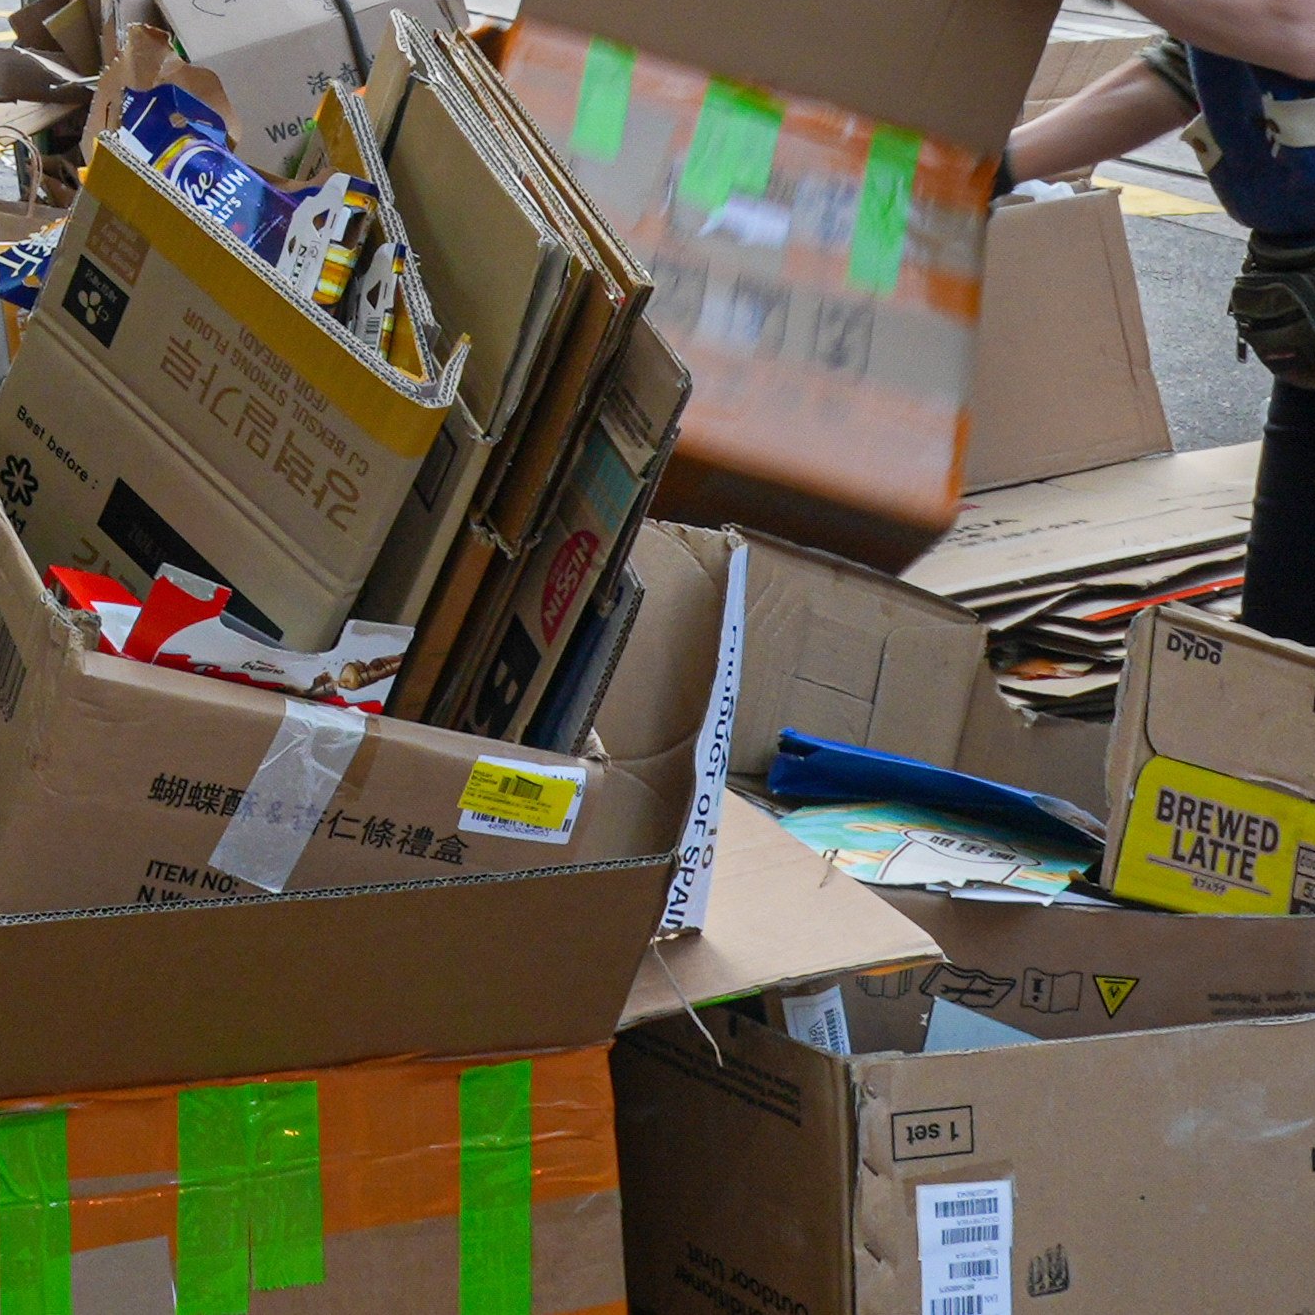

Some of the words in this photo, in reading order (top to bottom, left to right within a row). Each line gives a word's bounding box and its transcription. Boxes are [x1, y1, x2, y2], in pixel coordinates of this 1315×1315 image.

[182, 307, 230, 356] FLOUR
[230, 347, 286, 407] STRONG
[17, 404, 46, 442] Best
[47, 435, 89, 483] before
[159, 335, 361, 533] 강력밀가루
[293, 398, 347, 458] BEKSUL
[1166, 628, 1223, 665] DyDo
[1156, 789, 1279, 854] BREWED
[145, 859, 199, 887] ITEM
[201, 869, 240, 896] NO:
[1171, 828, 1257, 882] LATTE
[904, 1121, 941, 1145] set
[950, 1120, 960, 1141] 1
